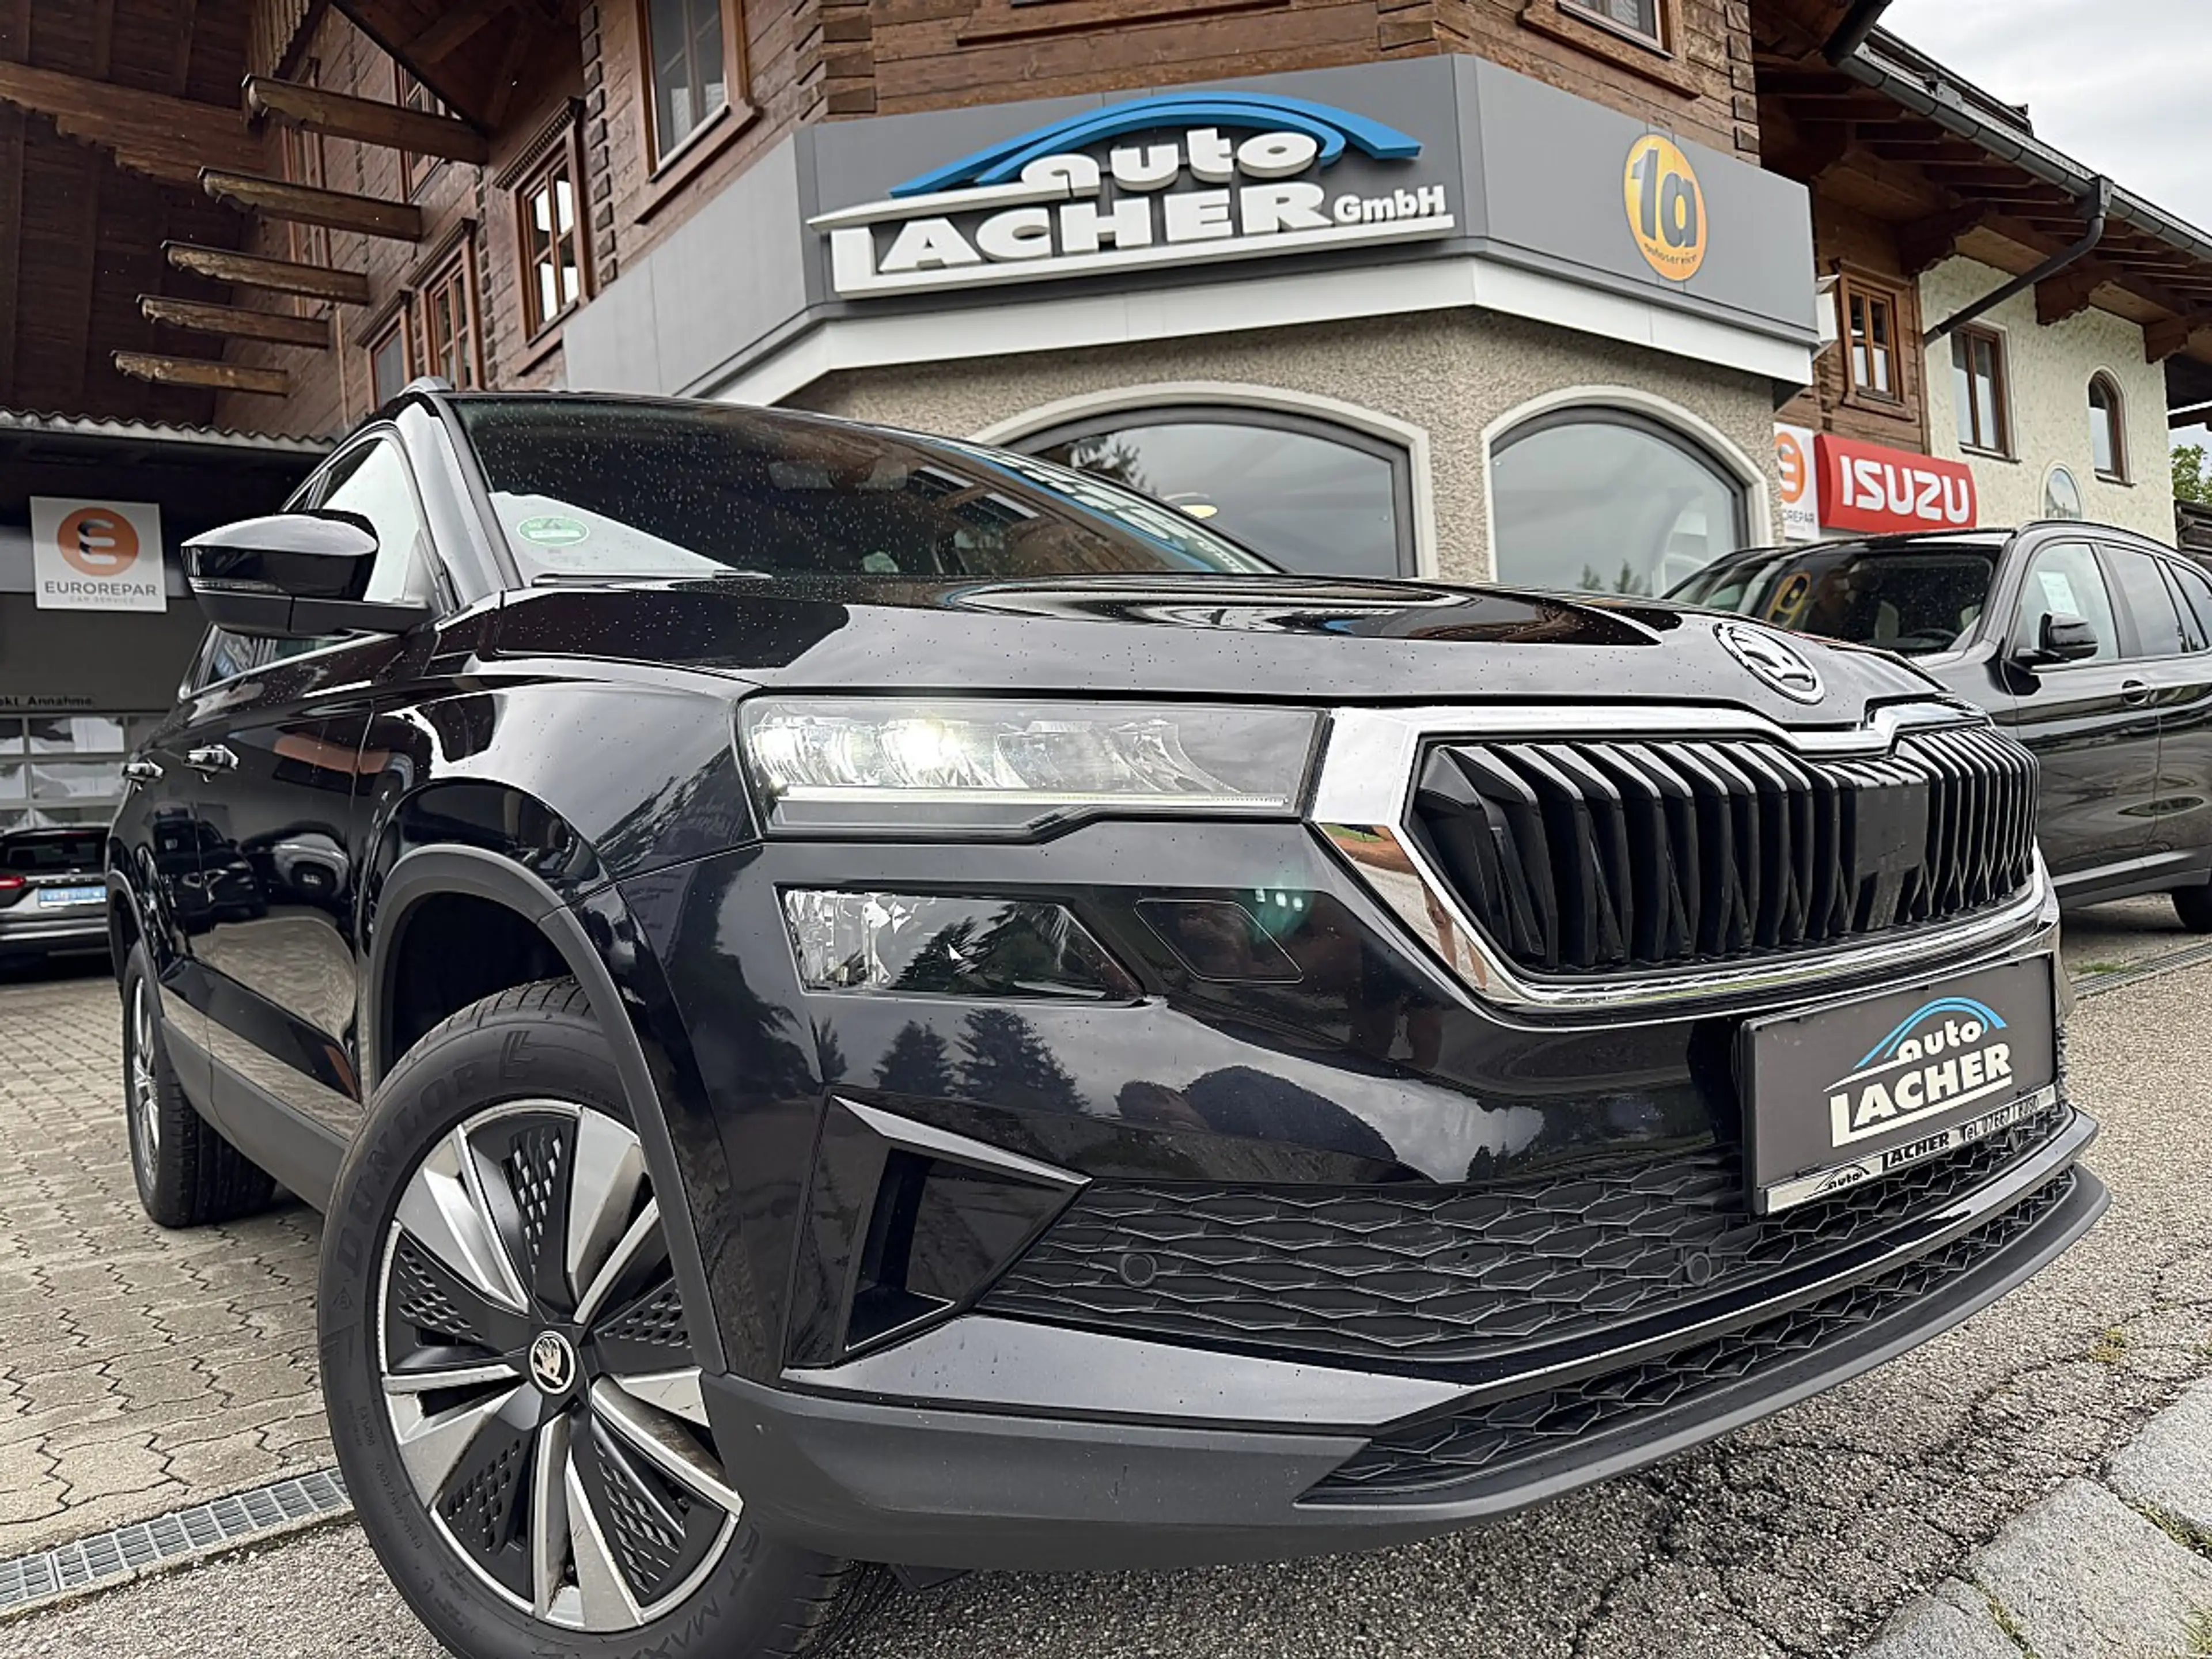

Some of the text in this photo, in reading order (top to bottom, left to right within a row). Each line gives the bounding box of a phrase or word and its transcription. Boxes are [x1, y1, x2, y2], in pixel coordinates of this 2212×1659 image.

[831, 182, 1446, 298] LACHER GmbH
[1839, 455, 1969, 524] ISUZU
[44, 580, 157, 596] EUROREPAR
[1896, 1019, 1983, 1064] auto
[1830, 1042, 2013, 1147] LACHER
[1881, 1132, 1950, 1172] LACHER
